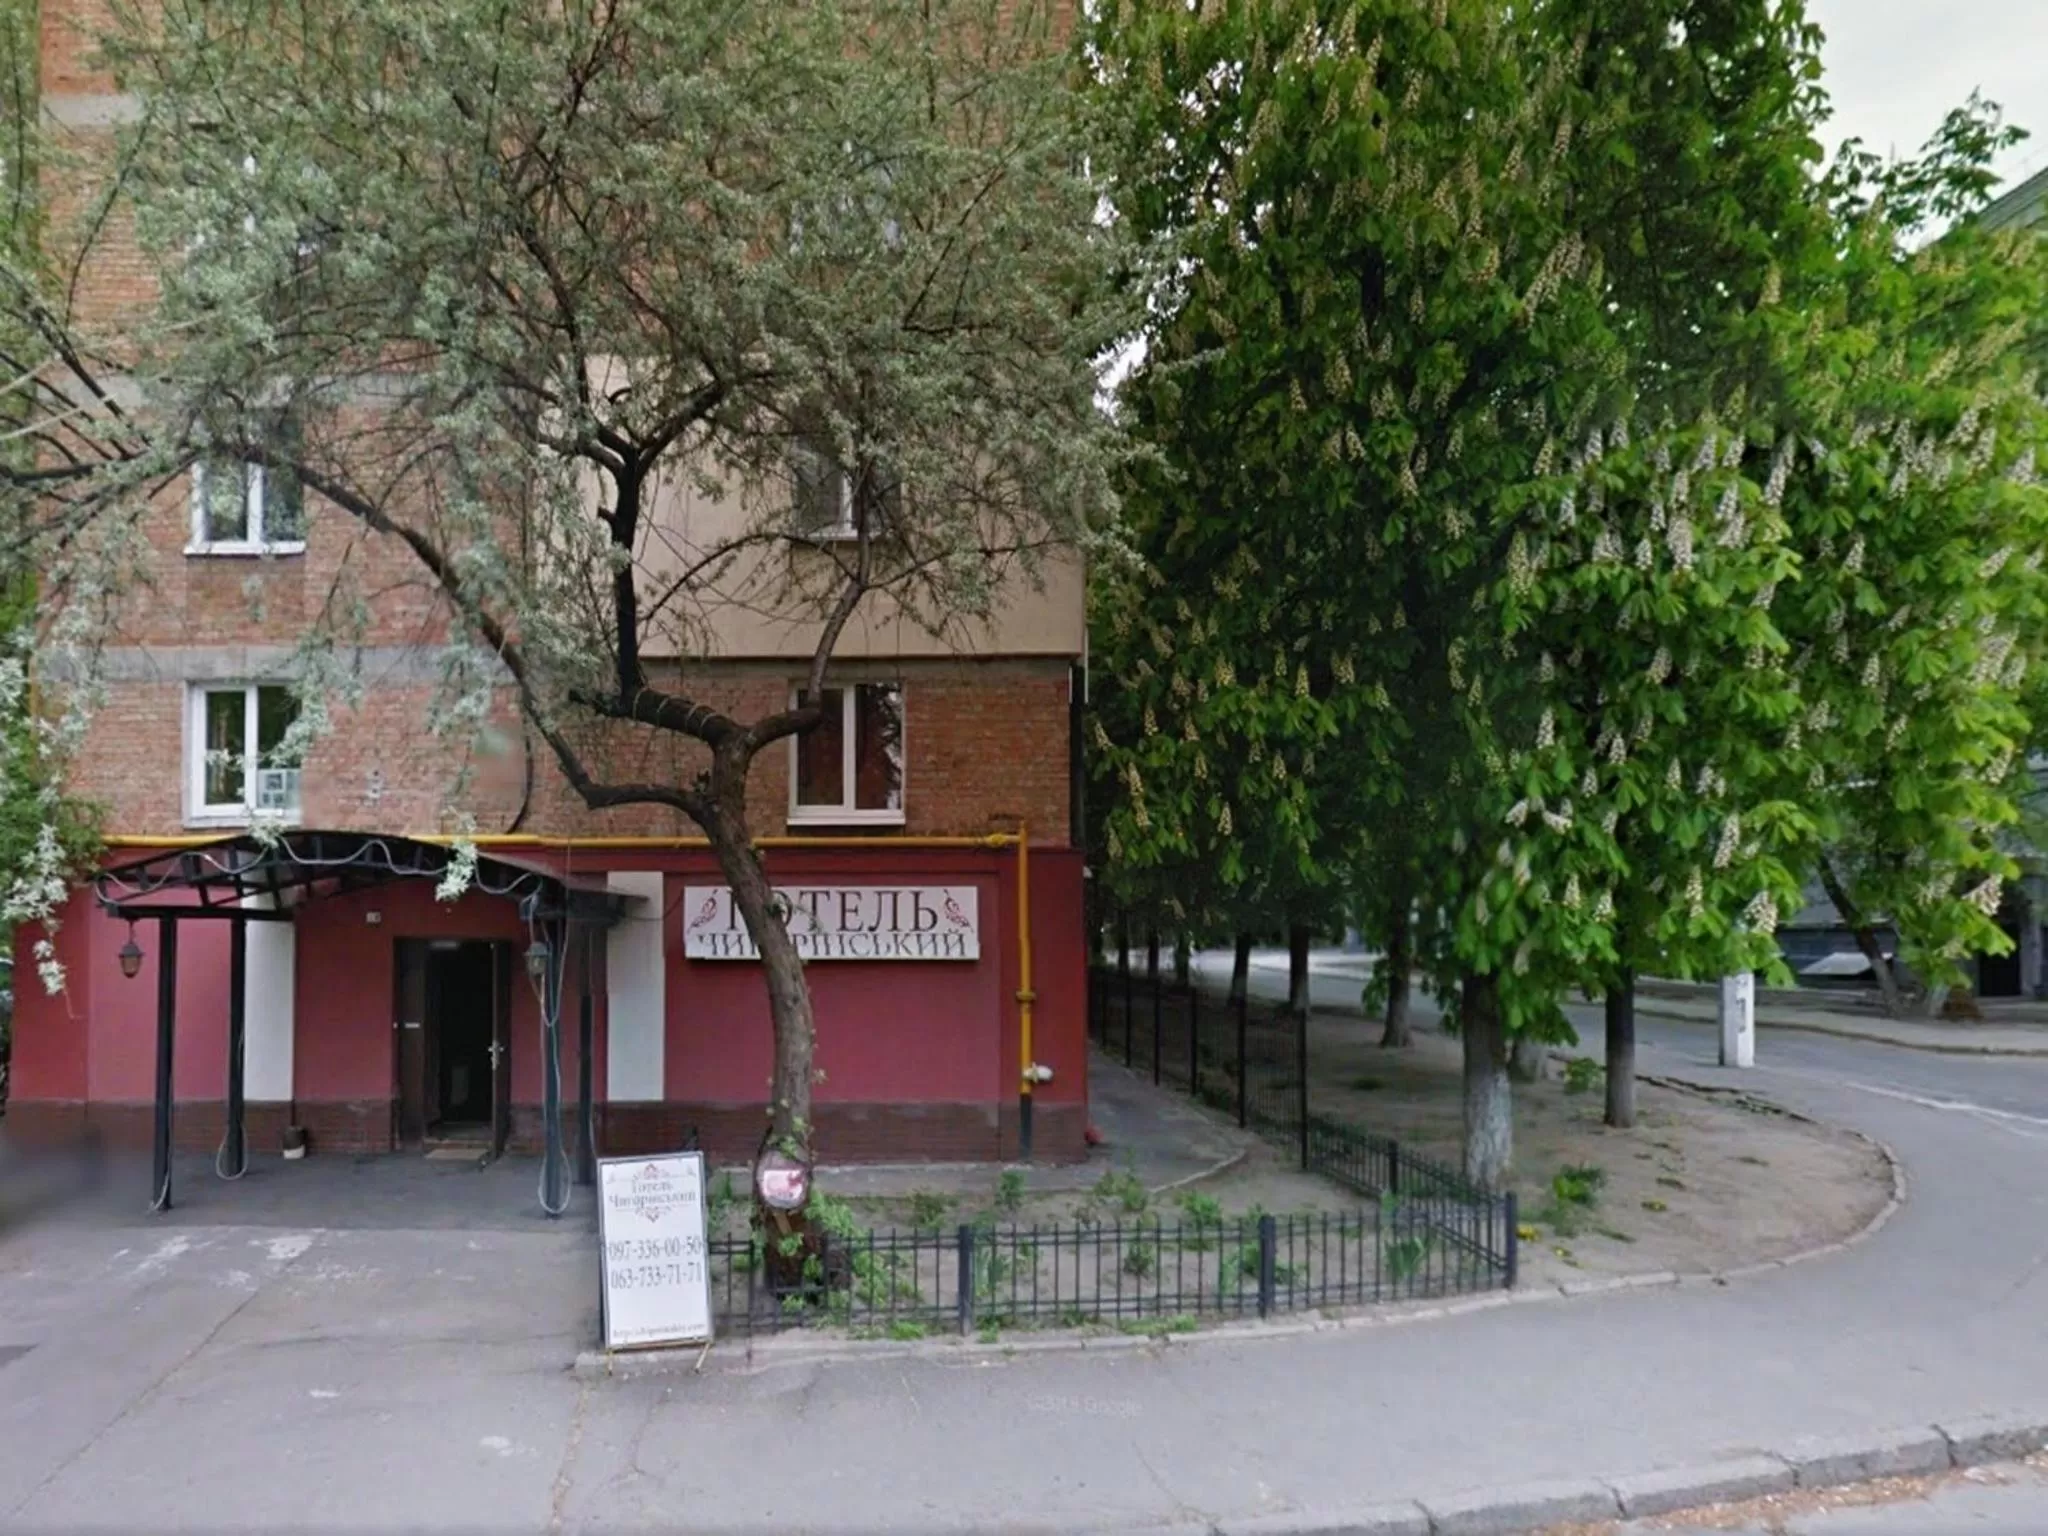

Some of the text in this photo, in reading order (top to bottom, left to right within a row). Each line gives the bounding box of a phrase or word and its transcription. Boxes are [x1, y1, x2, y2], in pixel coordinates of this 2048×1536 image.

[696, 928, 966, 957] ЧИРІНСЬКИЙ
[608, 1235, 702, 1261] 097-336-00-50
[611, 1262, 703, 1290] 063-733-71-71
